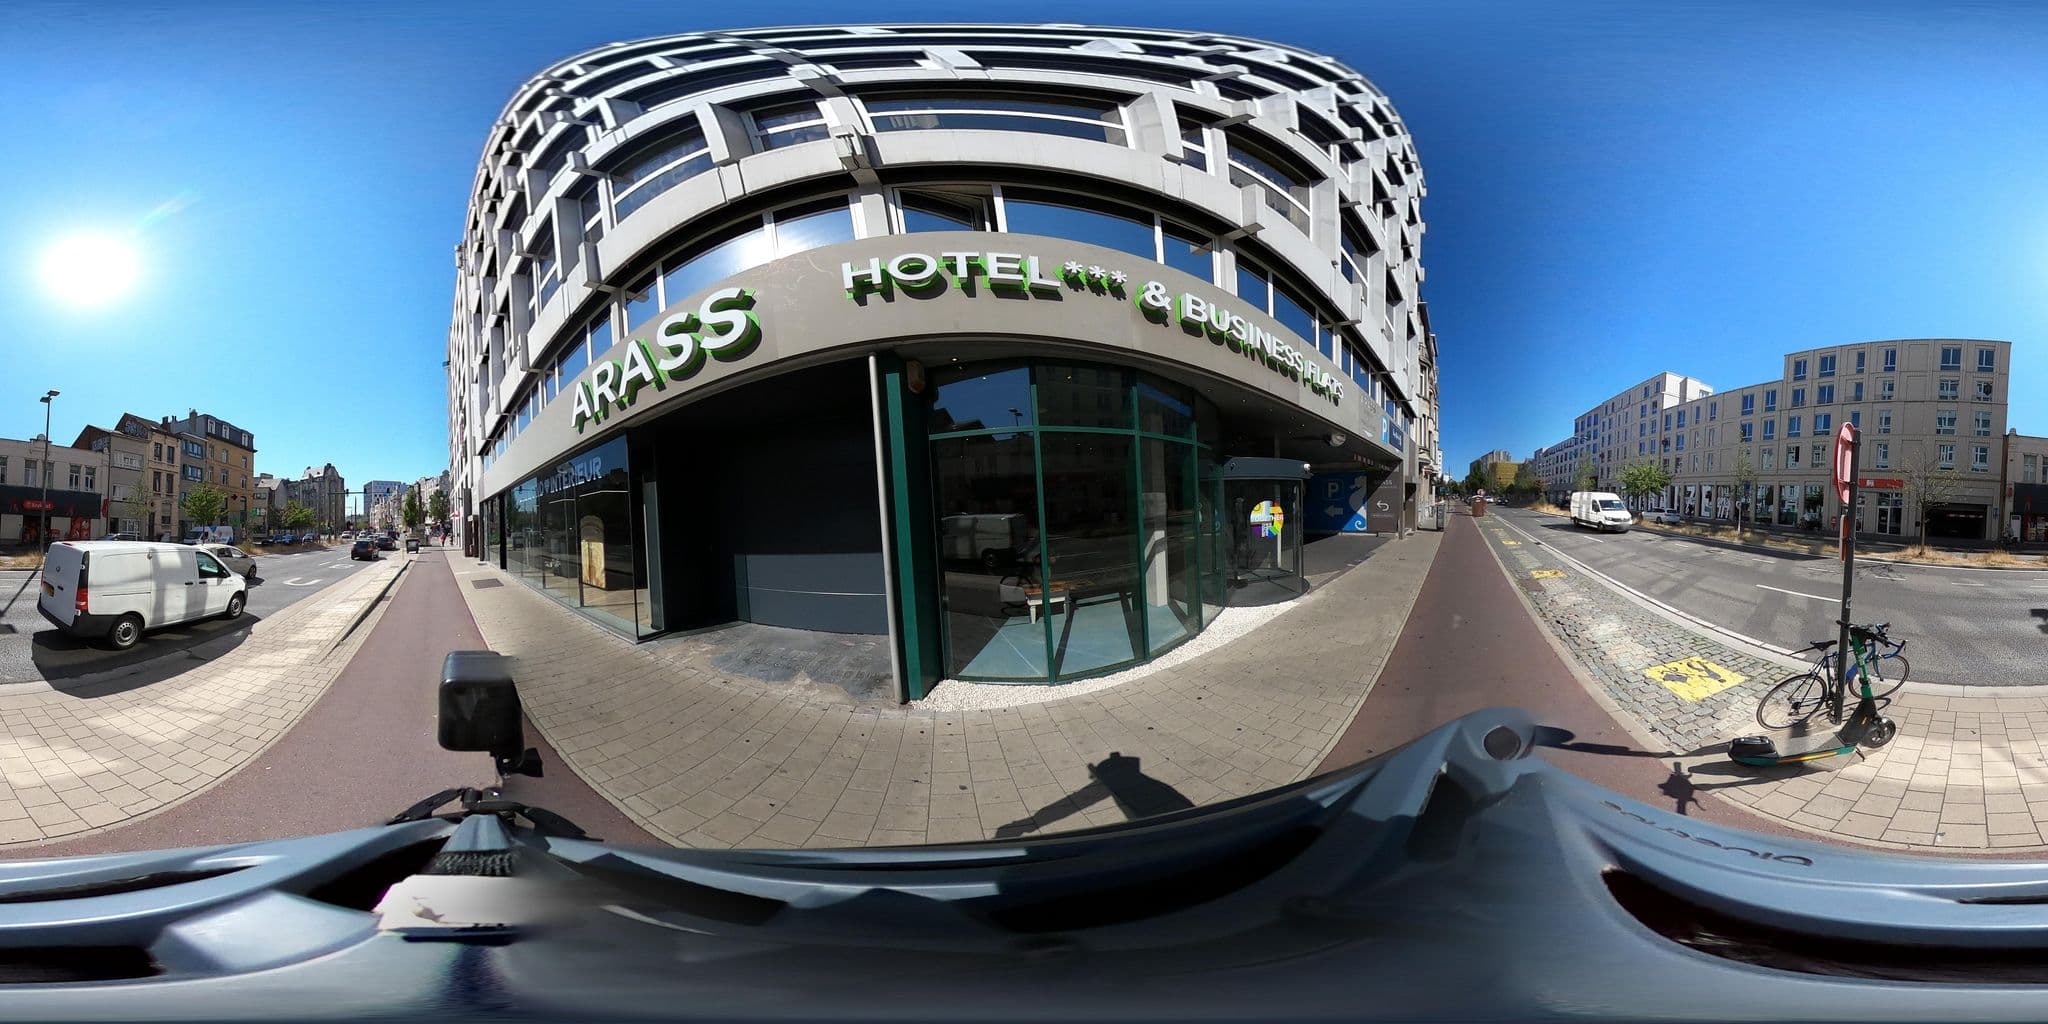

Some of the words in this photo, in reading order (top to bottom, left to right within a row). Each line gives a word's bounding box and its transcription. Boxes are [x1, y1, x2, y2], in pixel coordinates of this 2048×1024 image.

[571, 287, 755, 429] ARASS
[1144, 281, 1171, 310] &
[1181, 293, 1304, 373] BUSINESS
[1304, 359, 1344, 399] FLATS
